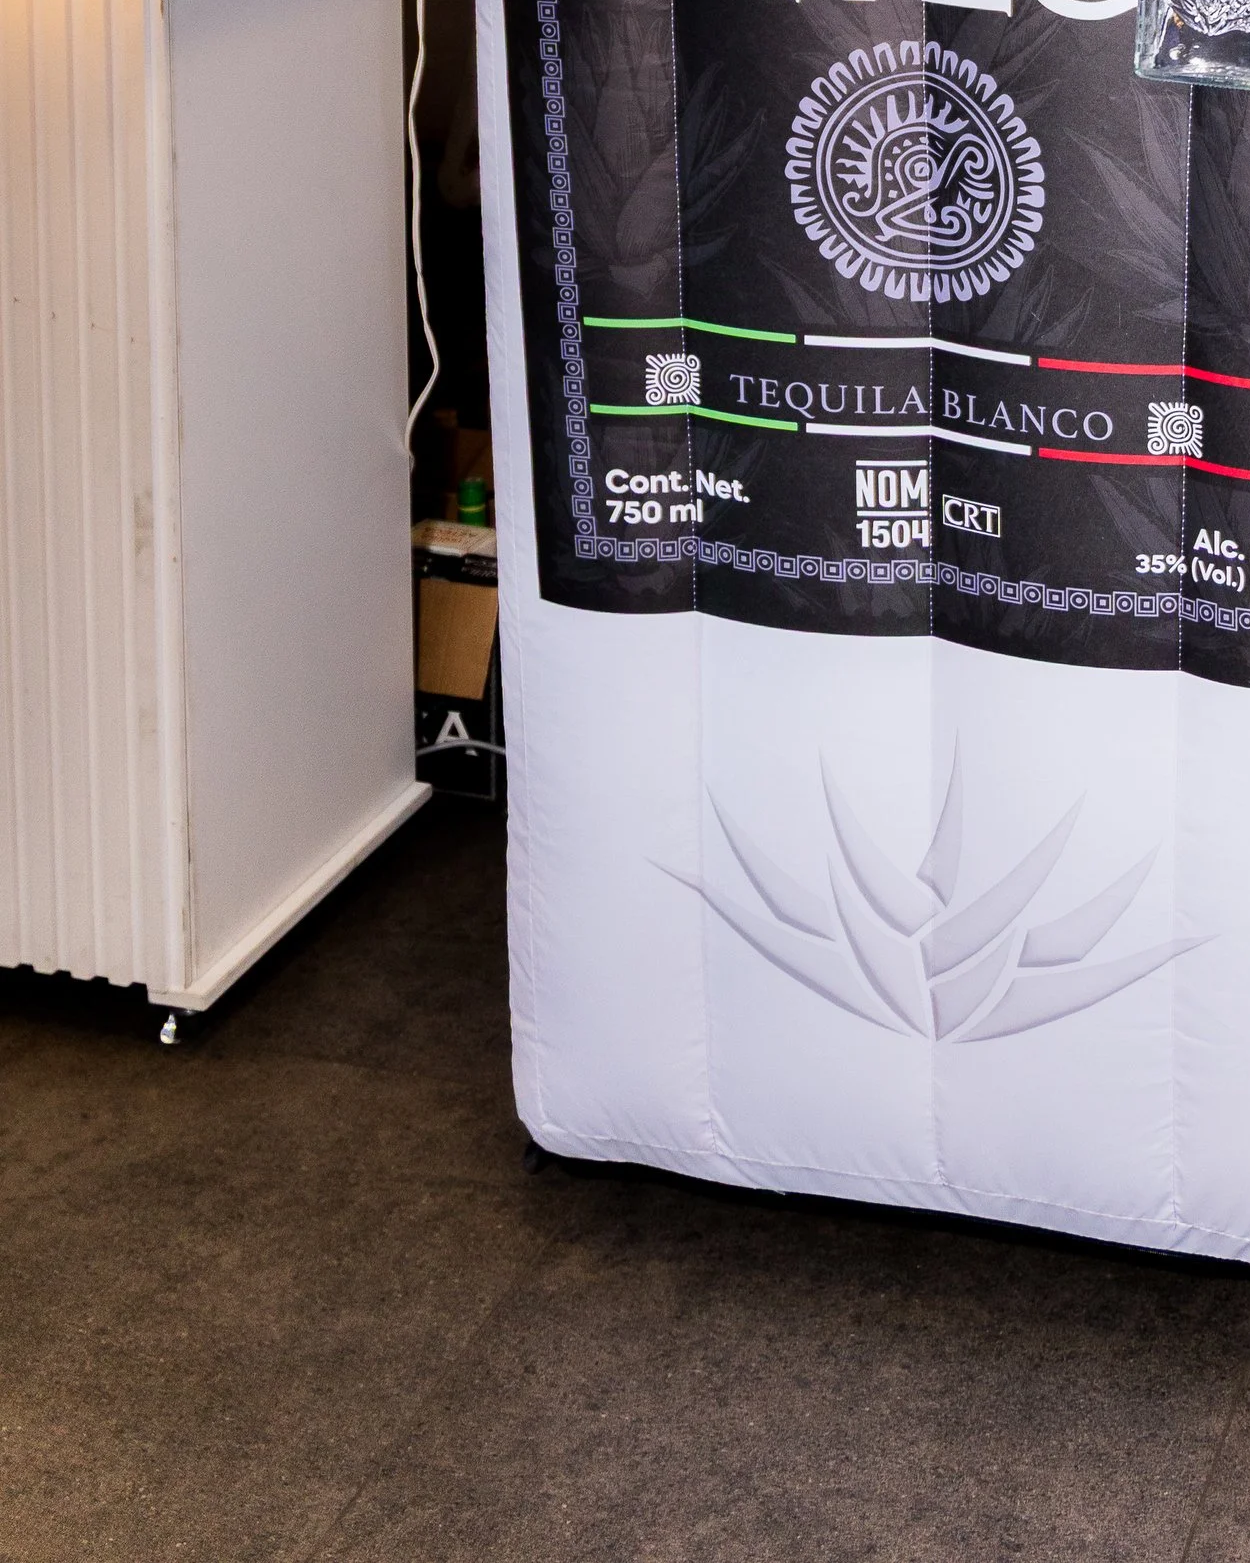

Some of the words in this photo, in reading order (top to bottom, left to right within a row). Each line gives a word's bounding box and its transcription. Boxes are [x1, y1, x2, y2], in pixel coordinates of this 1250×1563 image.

[730, 374, 929, 419] TEQUILA
[942, 389, 1114, 441] BLANCO
[606, 469, 690, 494] Cont.
[695, 469, 750, 503] Net.
[856, 470, 929, 508] NOM
[606, 500, 662, 524] 750
[669, 498, 704, 523] ml
[944, 498, 998, 533] CRT
[856, 519, 930, 548] 1504
[1193, 528, 1246, 561] Alc.
[1135, 553, 1188, 574] 35%
[1191, 556, 1246, 592] (Vol.)
